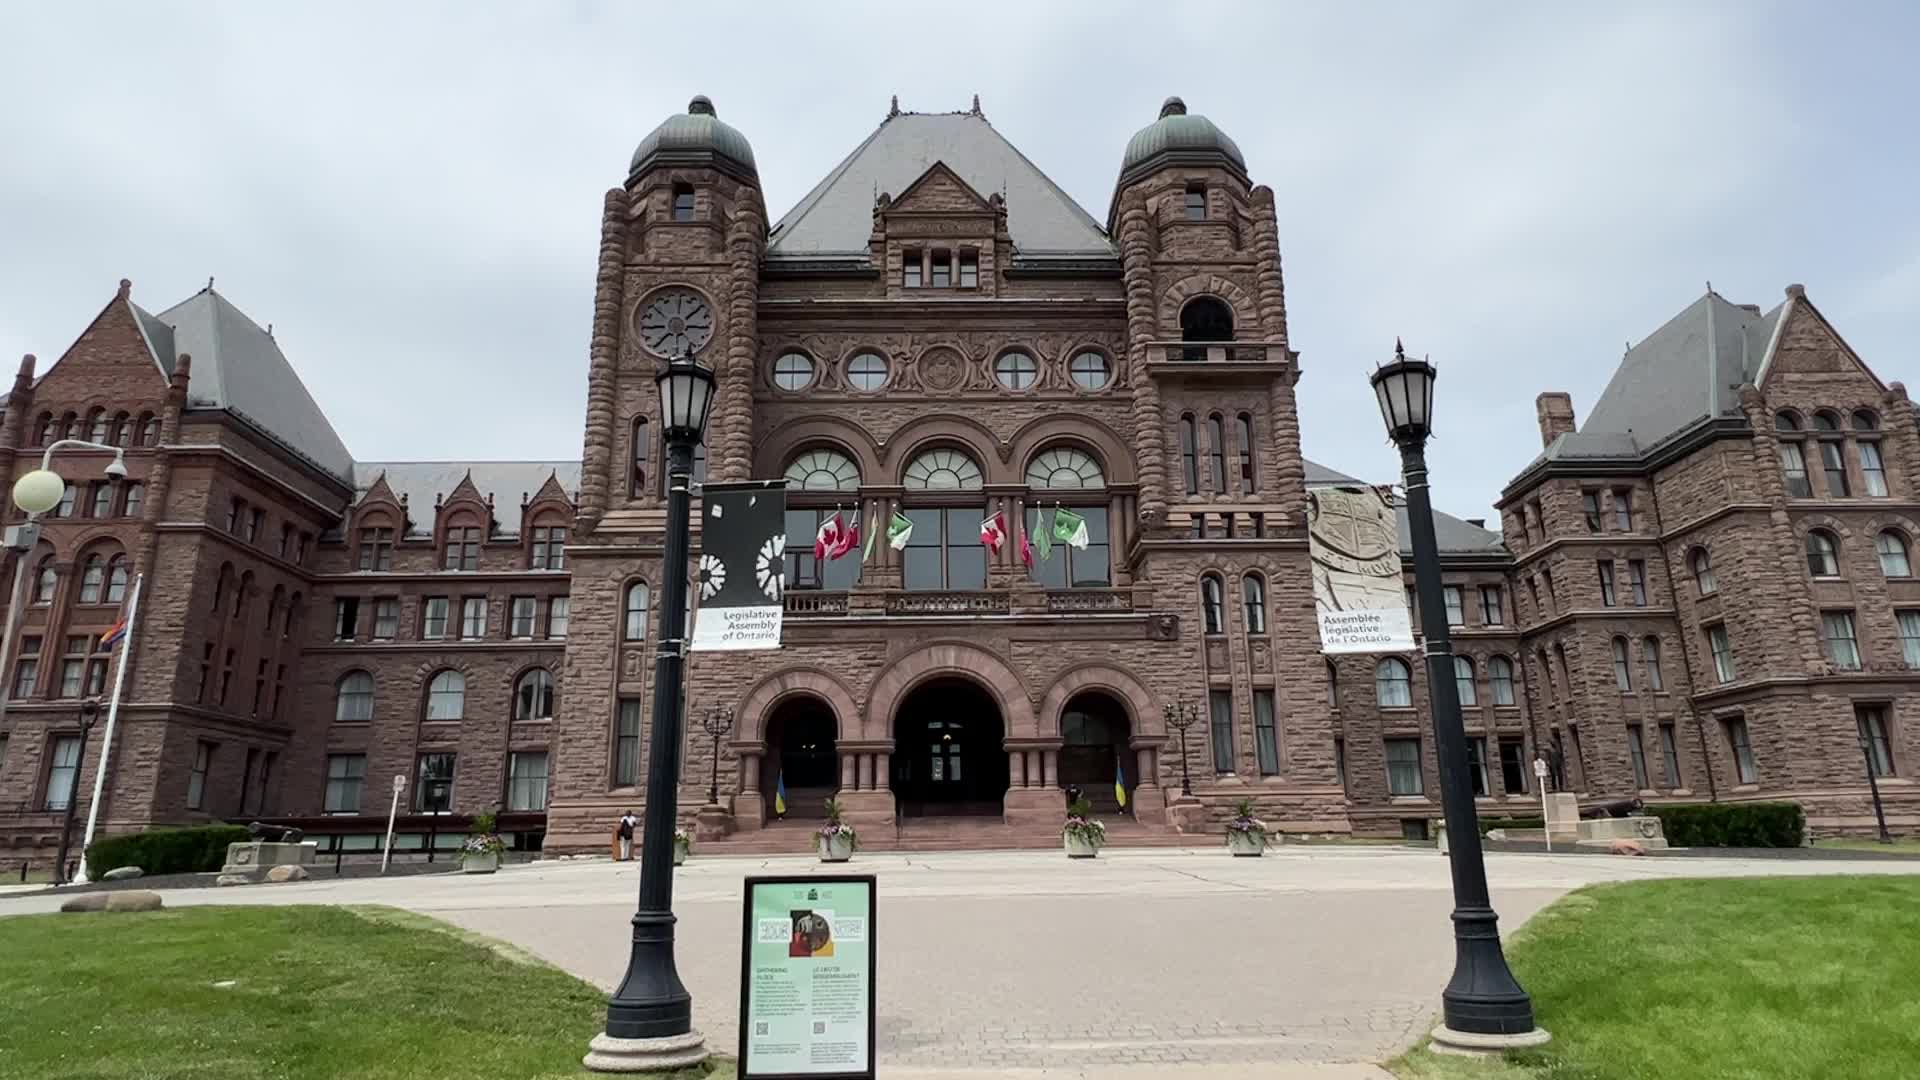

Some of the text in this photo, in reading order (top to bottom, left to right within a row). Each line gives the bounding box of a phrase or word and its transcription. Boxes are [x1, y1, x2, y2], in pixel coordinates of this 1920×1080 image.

[724, 609, 777, 621] Legislative
[728, 621, 777, 631] Assembly
[722, 631, 775, 641] of Ontario
